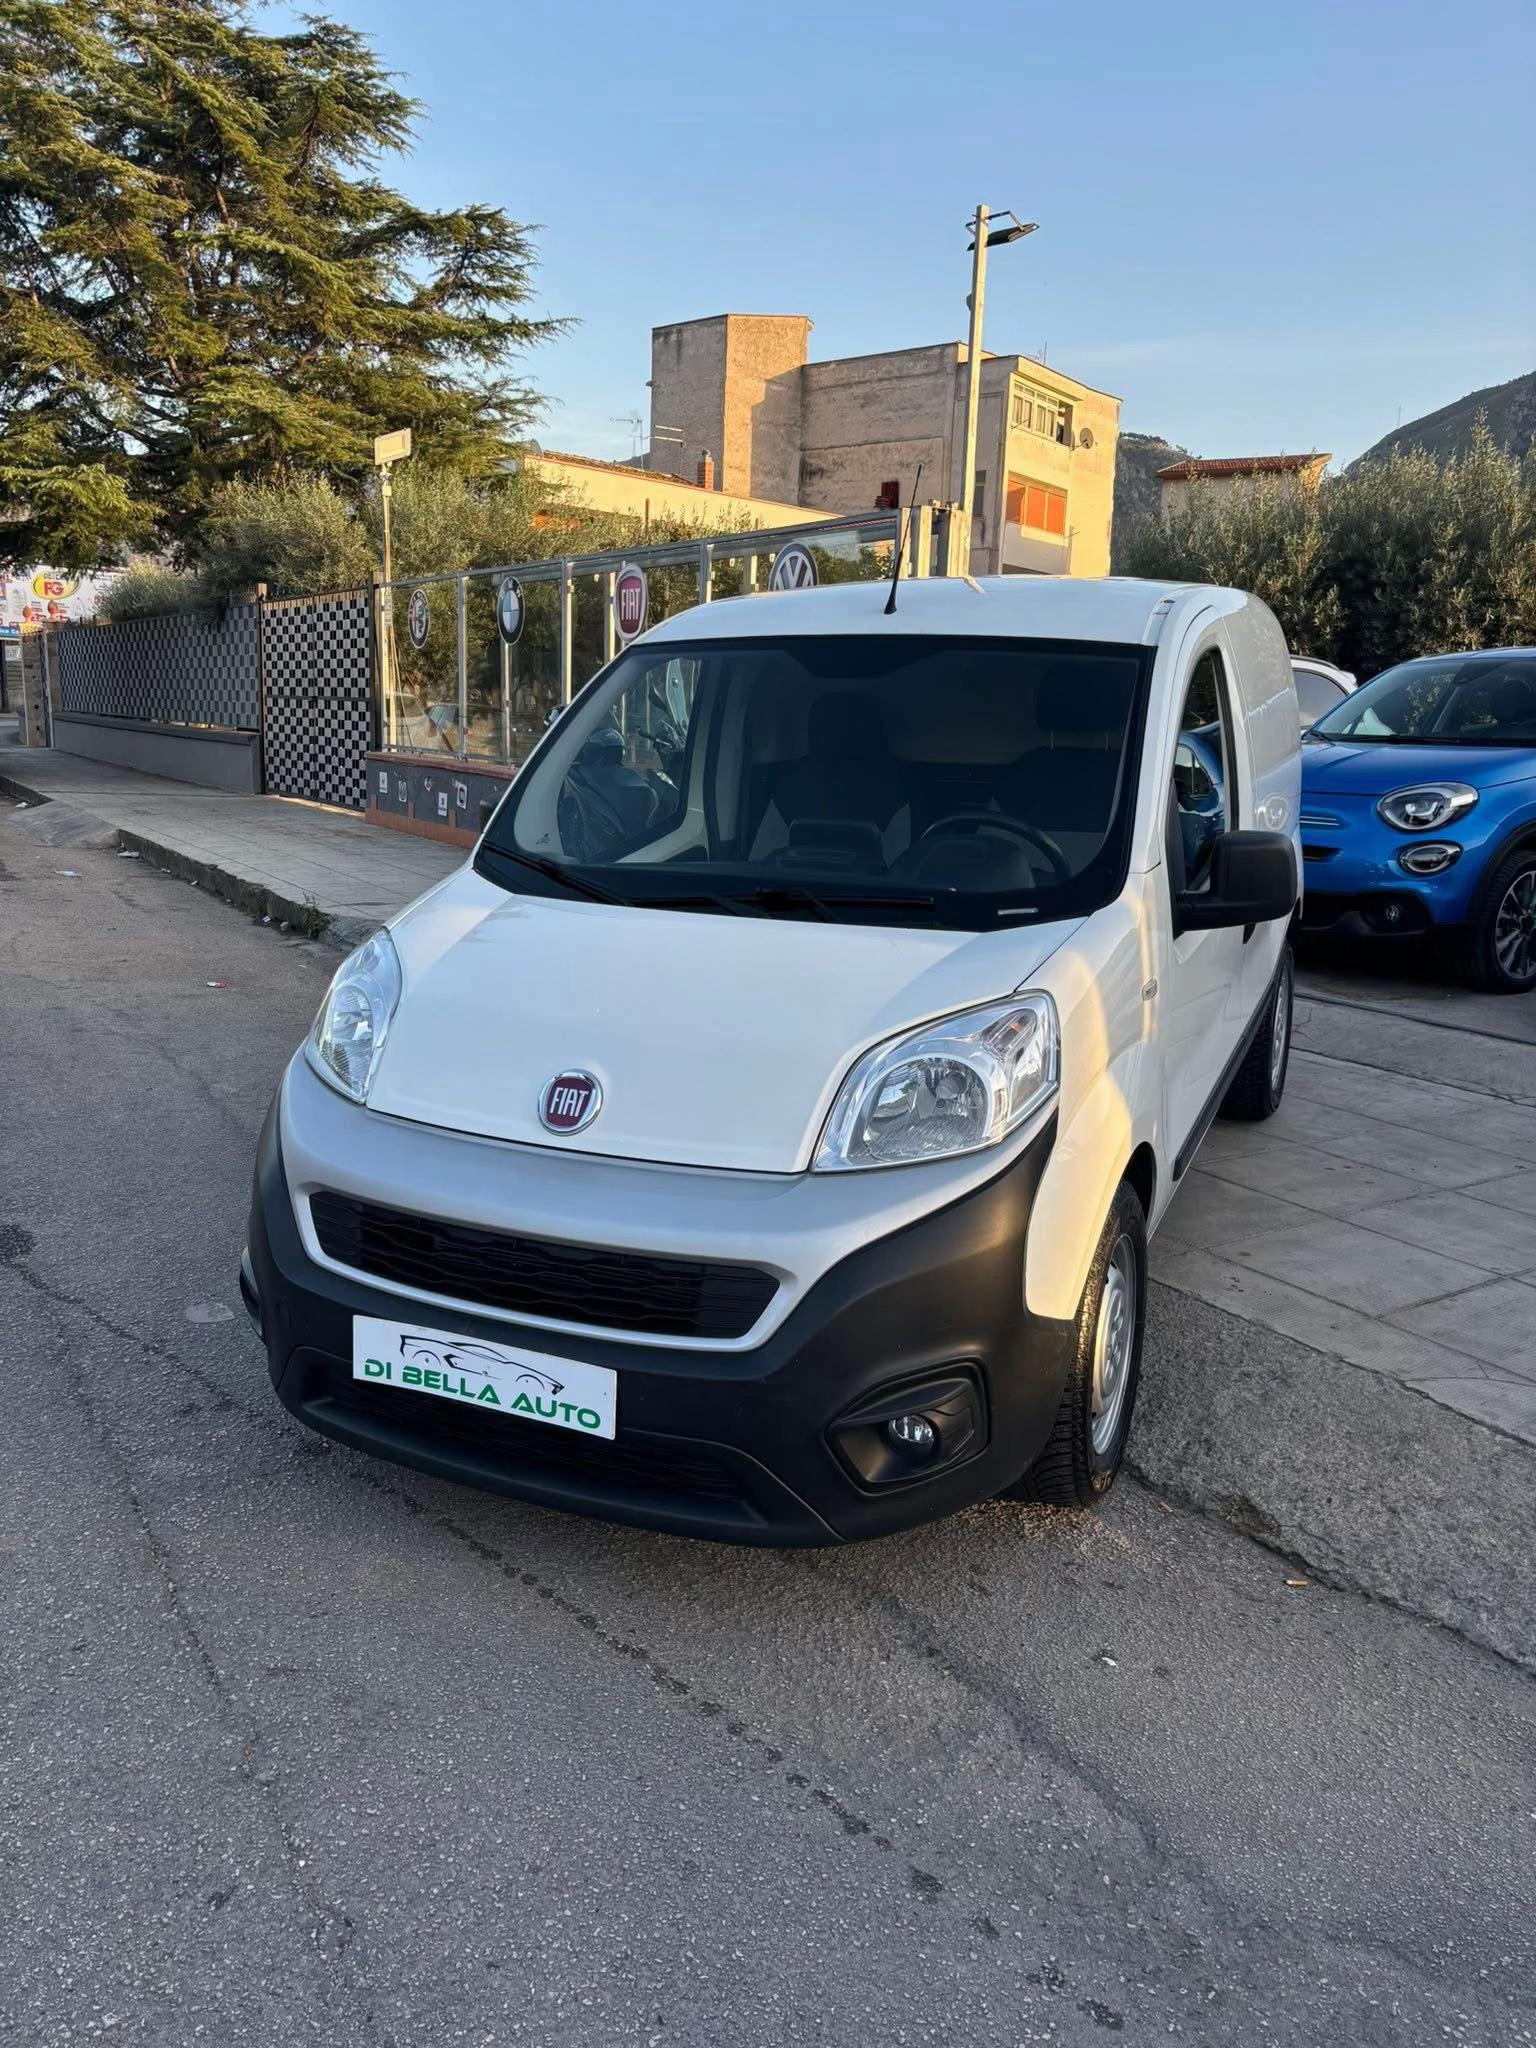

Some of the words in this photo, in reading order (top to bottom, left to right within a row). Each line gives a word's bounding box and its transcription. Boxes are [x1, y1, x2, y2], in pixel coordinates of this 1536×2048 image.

[621, 588, 640, 620] FIAT
[550, 1087, 589, 1117] FIAT
[364, 1358, 392, 1380] DI
[402, 1366, 501, 1405] BELLA
[511, 1392, 601, 1430] AUTO
